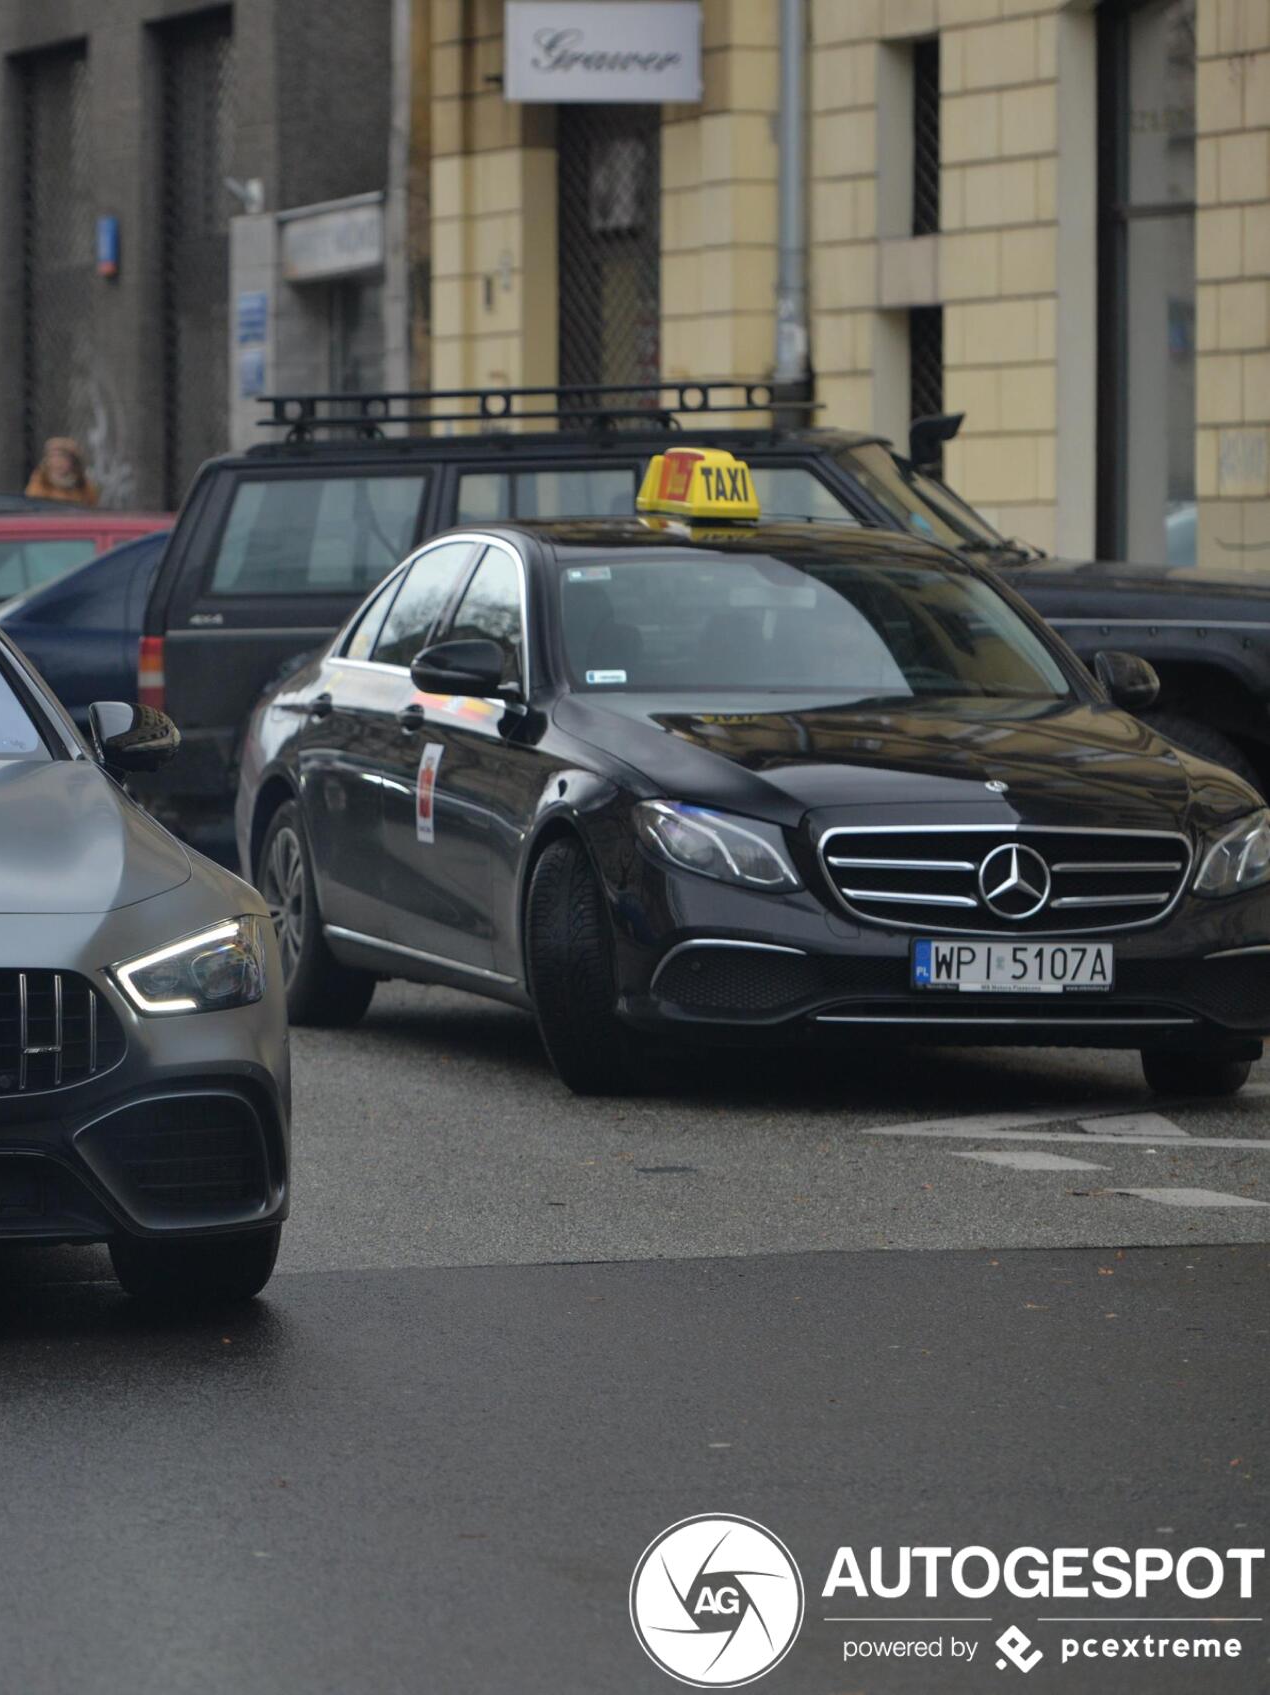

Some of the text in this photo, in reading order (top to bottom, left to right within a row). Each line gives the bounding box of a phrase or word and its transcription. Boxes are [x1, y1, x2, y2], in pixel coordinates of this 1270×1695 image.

[531, 27, 681, 74] Grawer
[700, 467, 749, 502] TAXI
[916, 967, 929, 977] PL
[934, 946, 1107, 981] WPI 5107A
